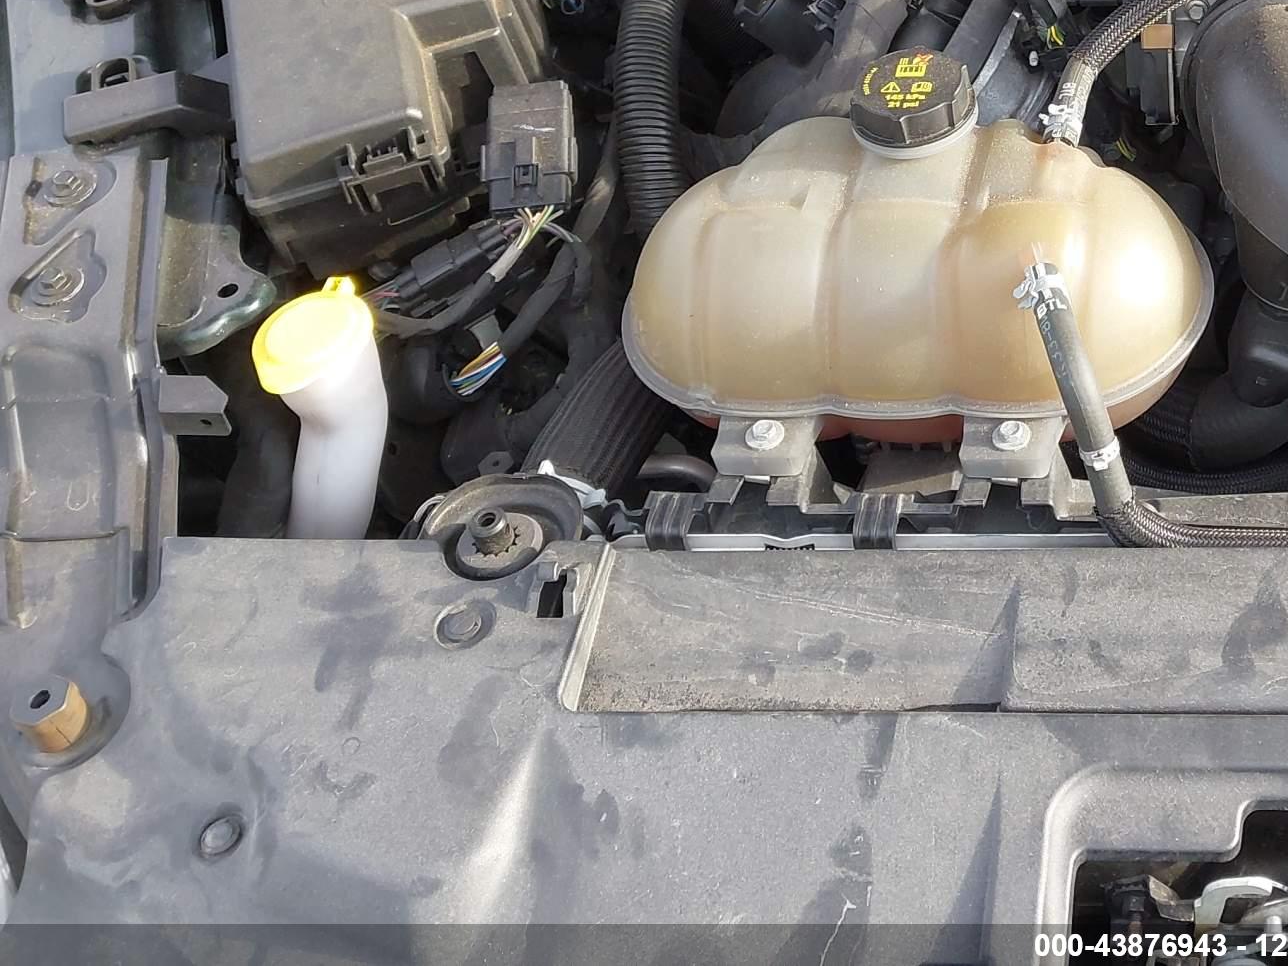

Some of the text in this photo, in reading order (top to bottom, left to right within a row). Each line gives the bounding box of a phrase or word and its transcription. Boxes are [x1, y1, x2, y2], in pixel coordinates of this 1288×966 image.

[885, 93, 926, 101] 145 kPa
[902, 101, 920, 109] psi
[1036, 298, 1068, 320] BTL
